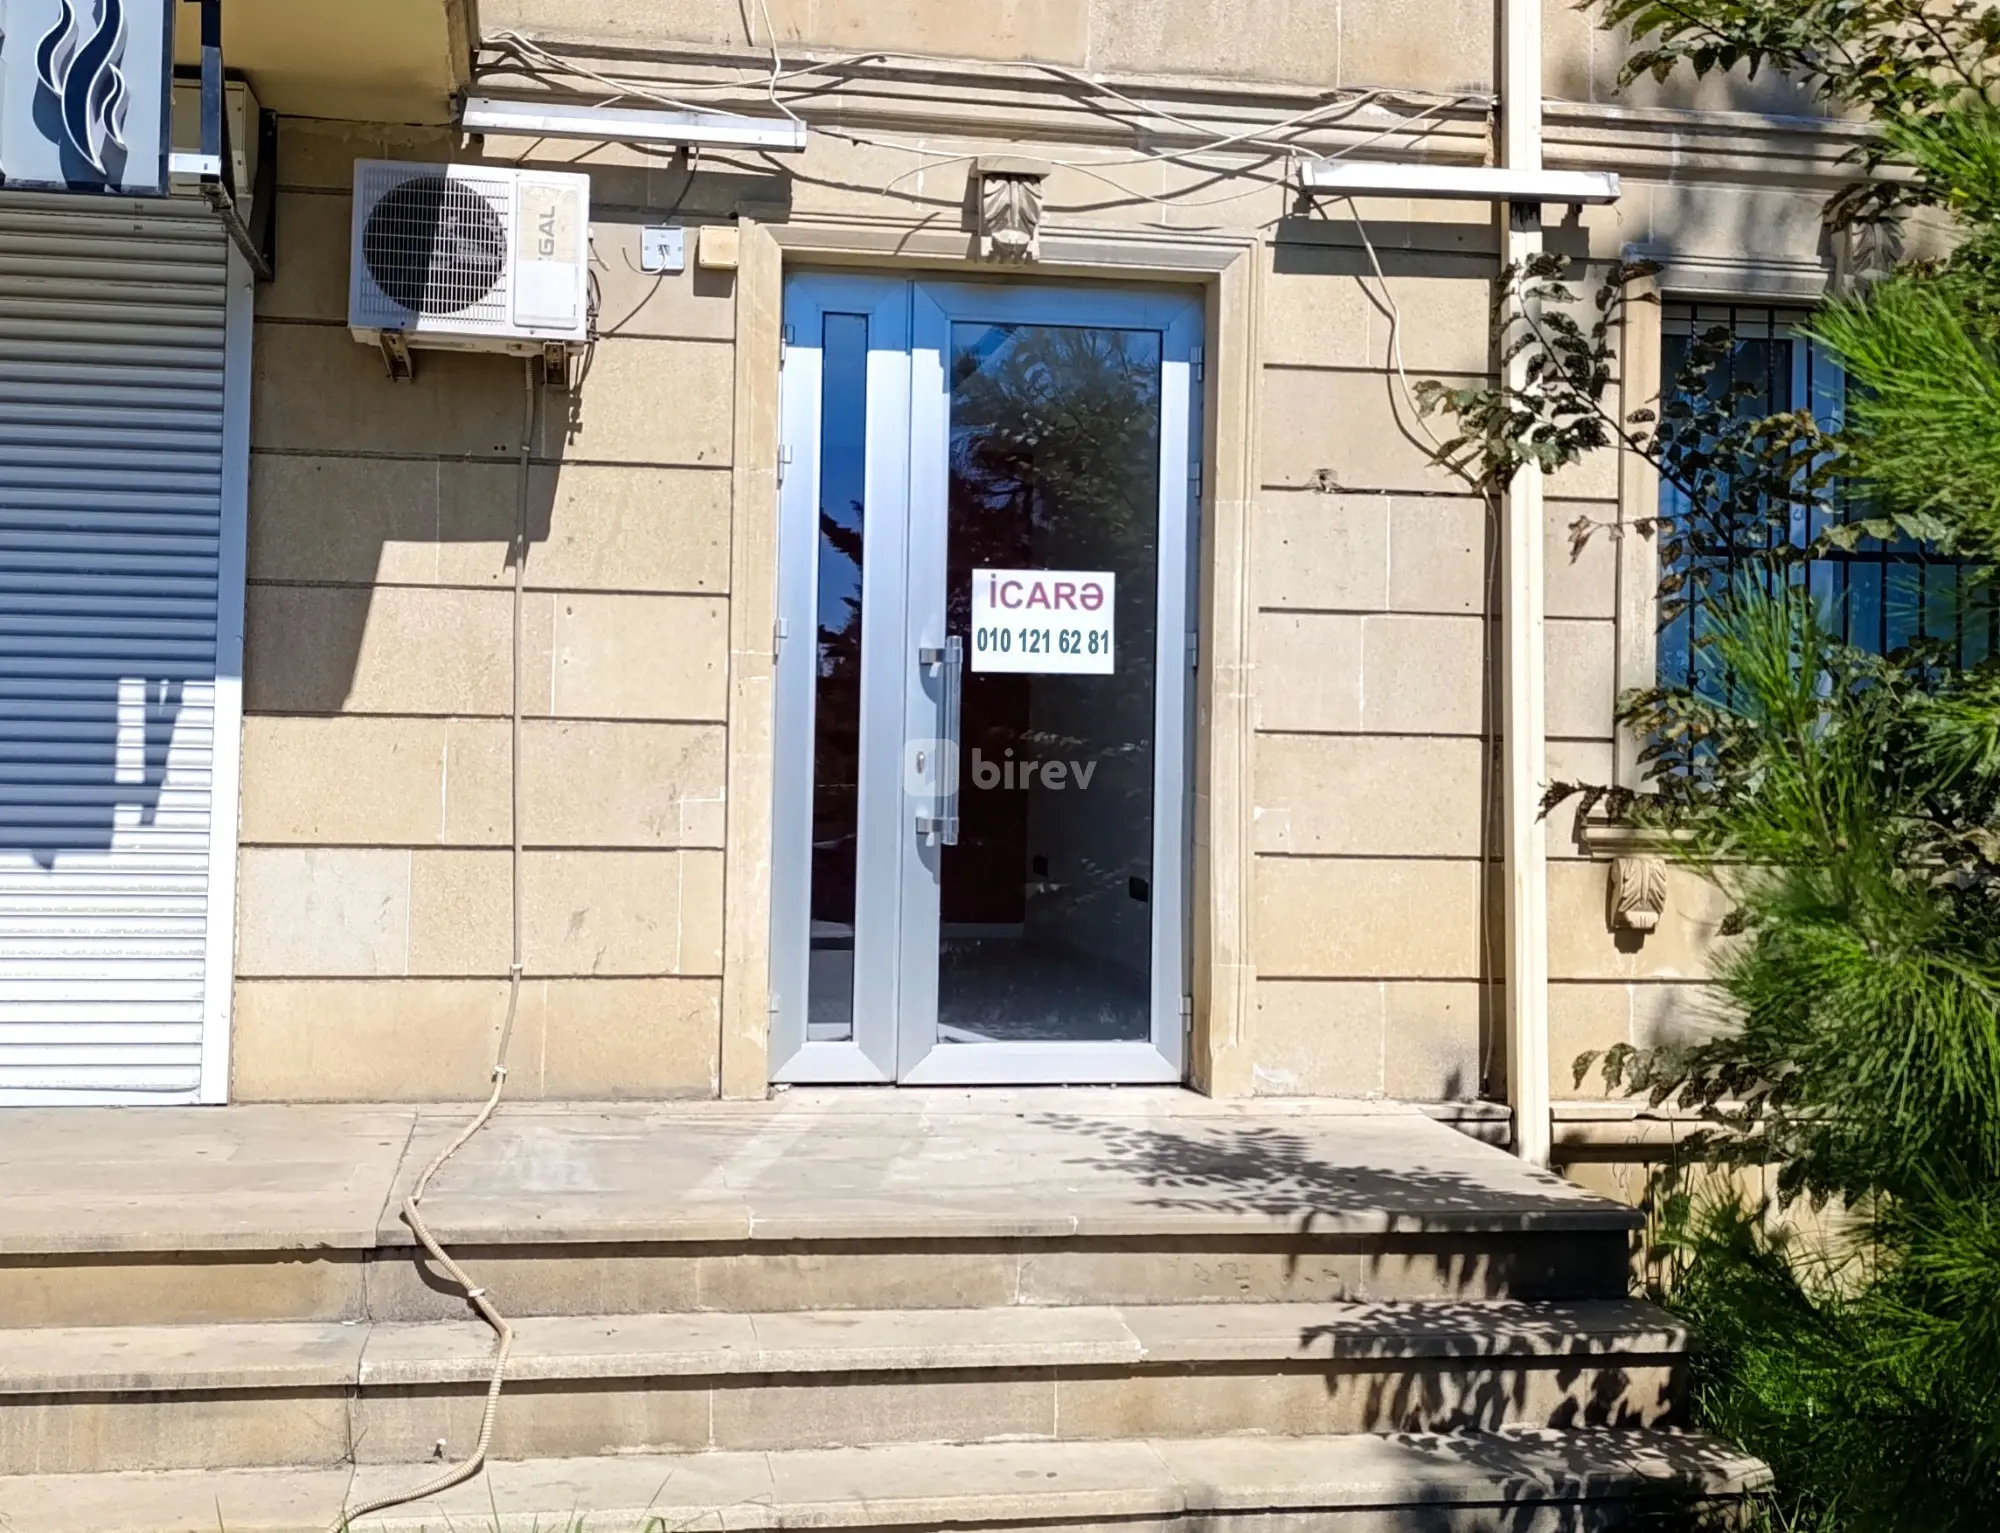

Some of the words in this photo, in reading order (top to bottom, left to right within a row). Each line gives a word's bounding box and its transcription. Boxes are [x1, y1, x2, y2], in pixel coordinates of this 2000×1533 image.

[538, 205, 555, 260] GAL
[989, 573, 1104, 611] İCARƏ
[976, 627, 1011, 652] 010
[1018, 628, 1050, 653] 121
[1058, 629, 1081, 654] 62
[1088, 629, 1109, 654] 81
